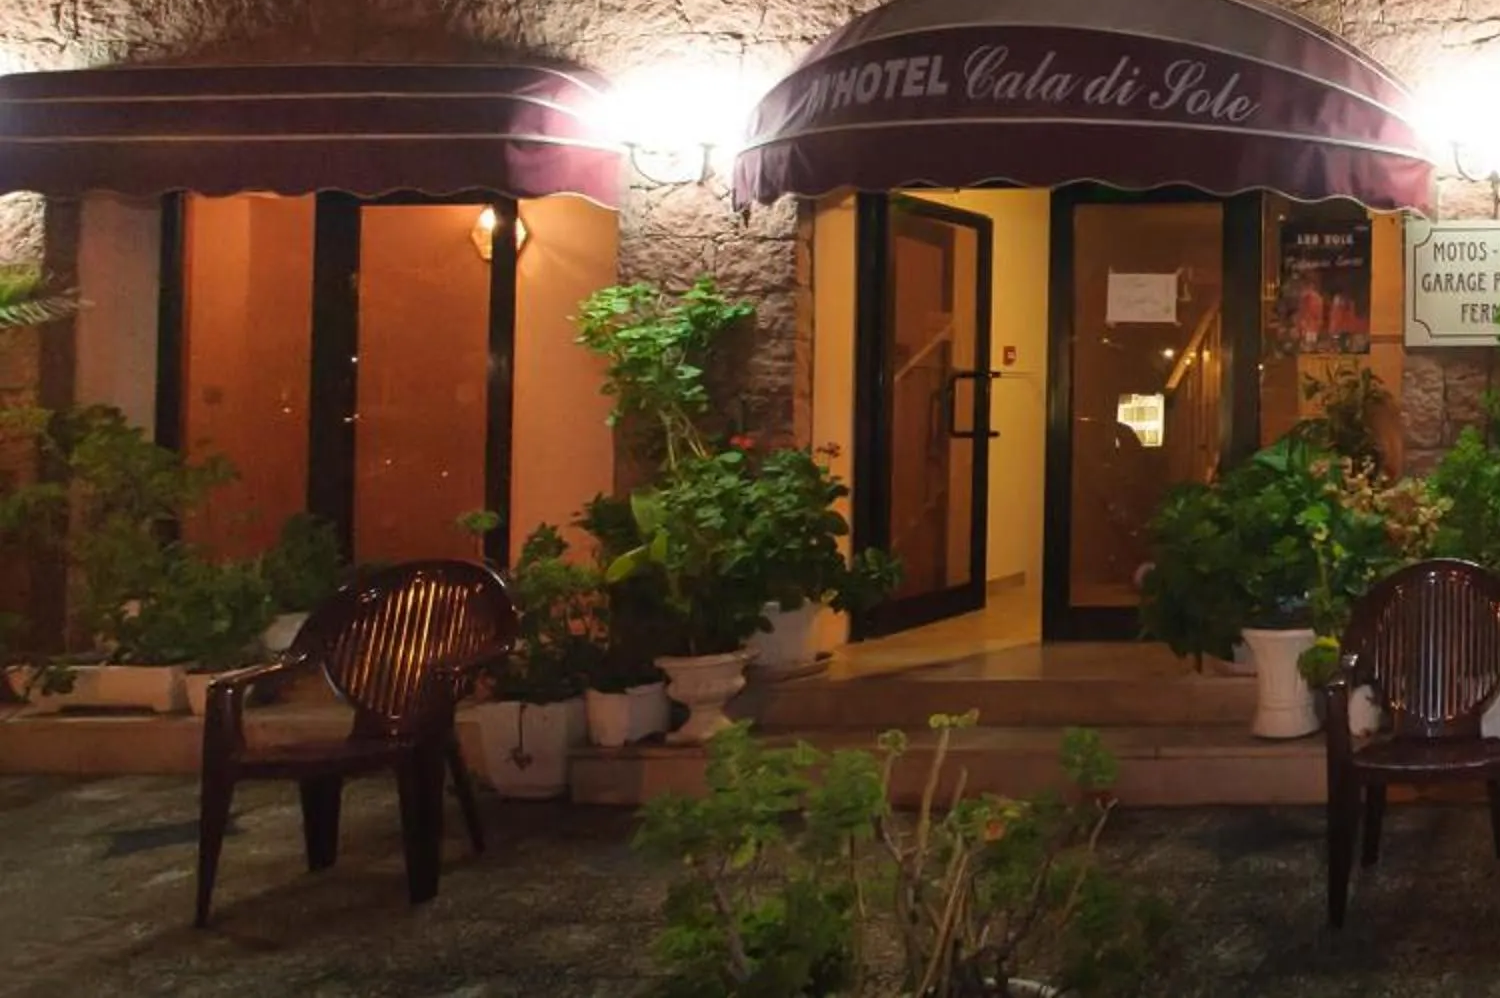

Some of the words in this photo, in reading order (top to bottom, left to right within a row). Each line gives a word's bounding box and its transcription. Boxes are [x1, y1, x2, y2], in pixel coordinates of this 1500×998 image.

[964, 45, 1079, 103] Cala
[1083, 56, 1143, 105] di
[1150, 58, 1260, 122] Sole
[1433, 241, 1487, 262] MOTOS
[1421, 272, 1487, 293] GARAGE
